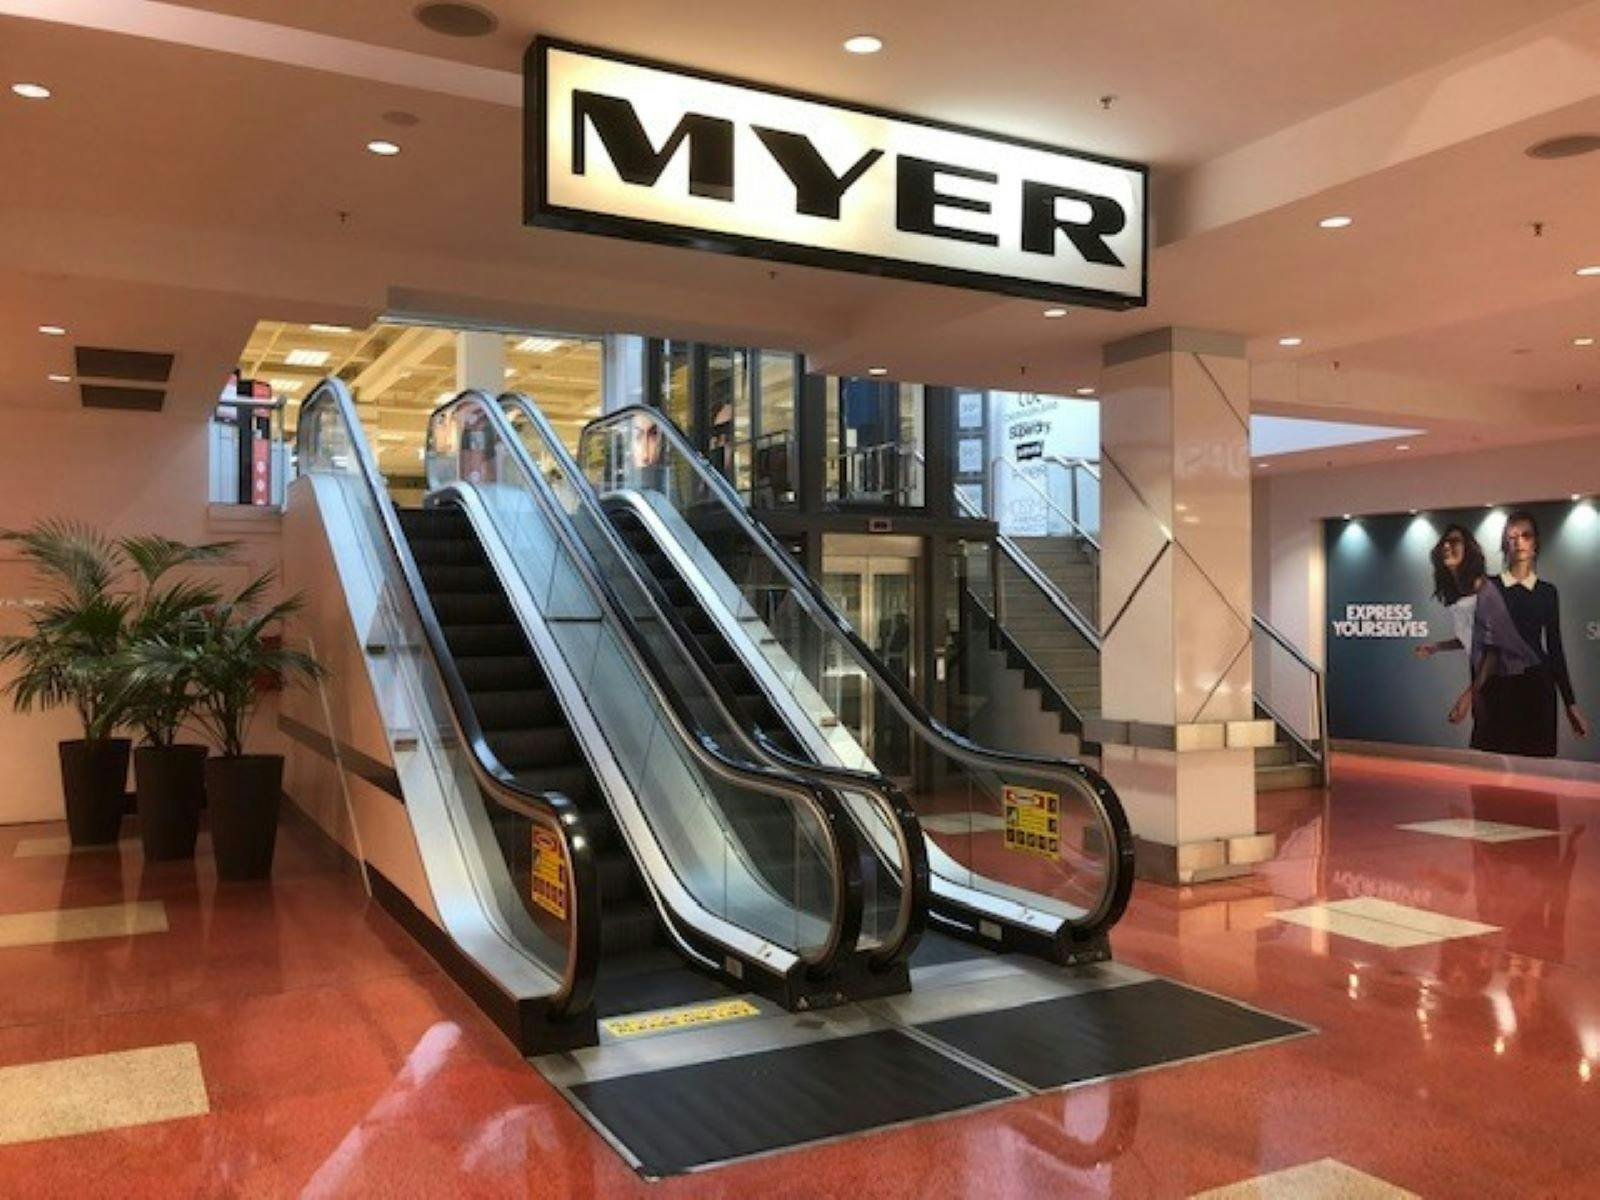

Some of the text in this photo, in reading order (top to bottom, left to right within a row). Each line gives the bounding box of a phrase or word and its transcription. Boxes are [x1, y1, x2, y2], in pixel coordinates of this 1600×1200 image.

[570, 88, 1127, 268] MYER
[1346, 604, 1413, 620] EXPRESS
[1332, 621, 1428, 637] YOURSELVES
